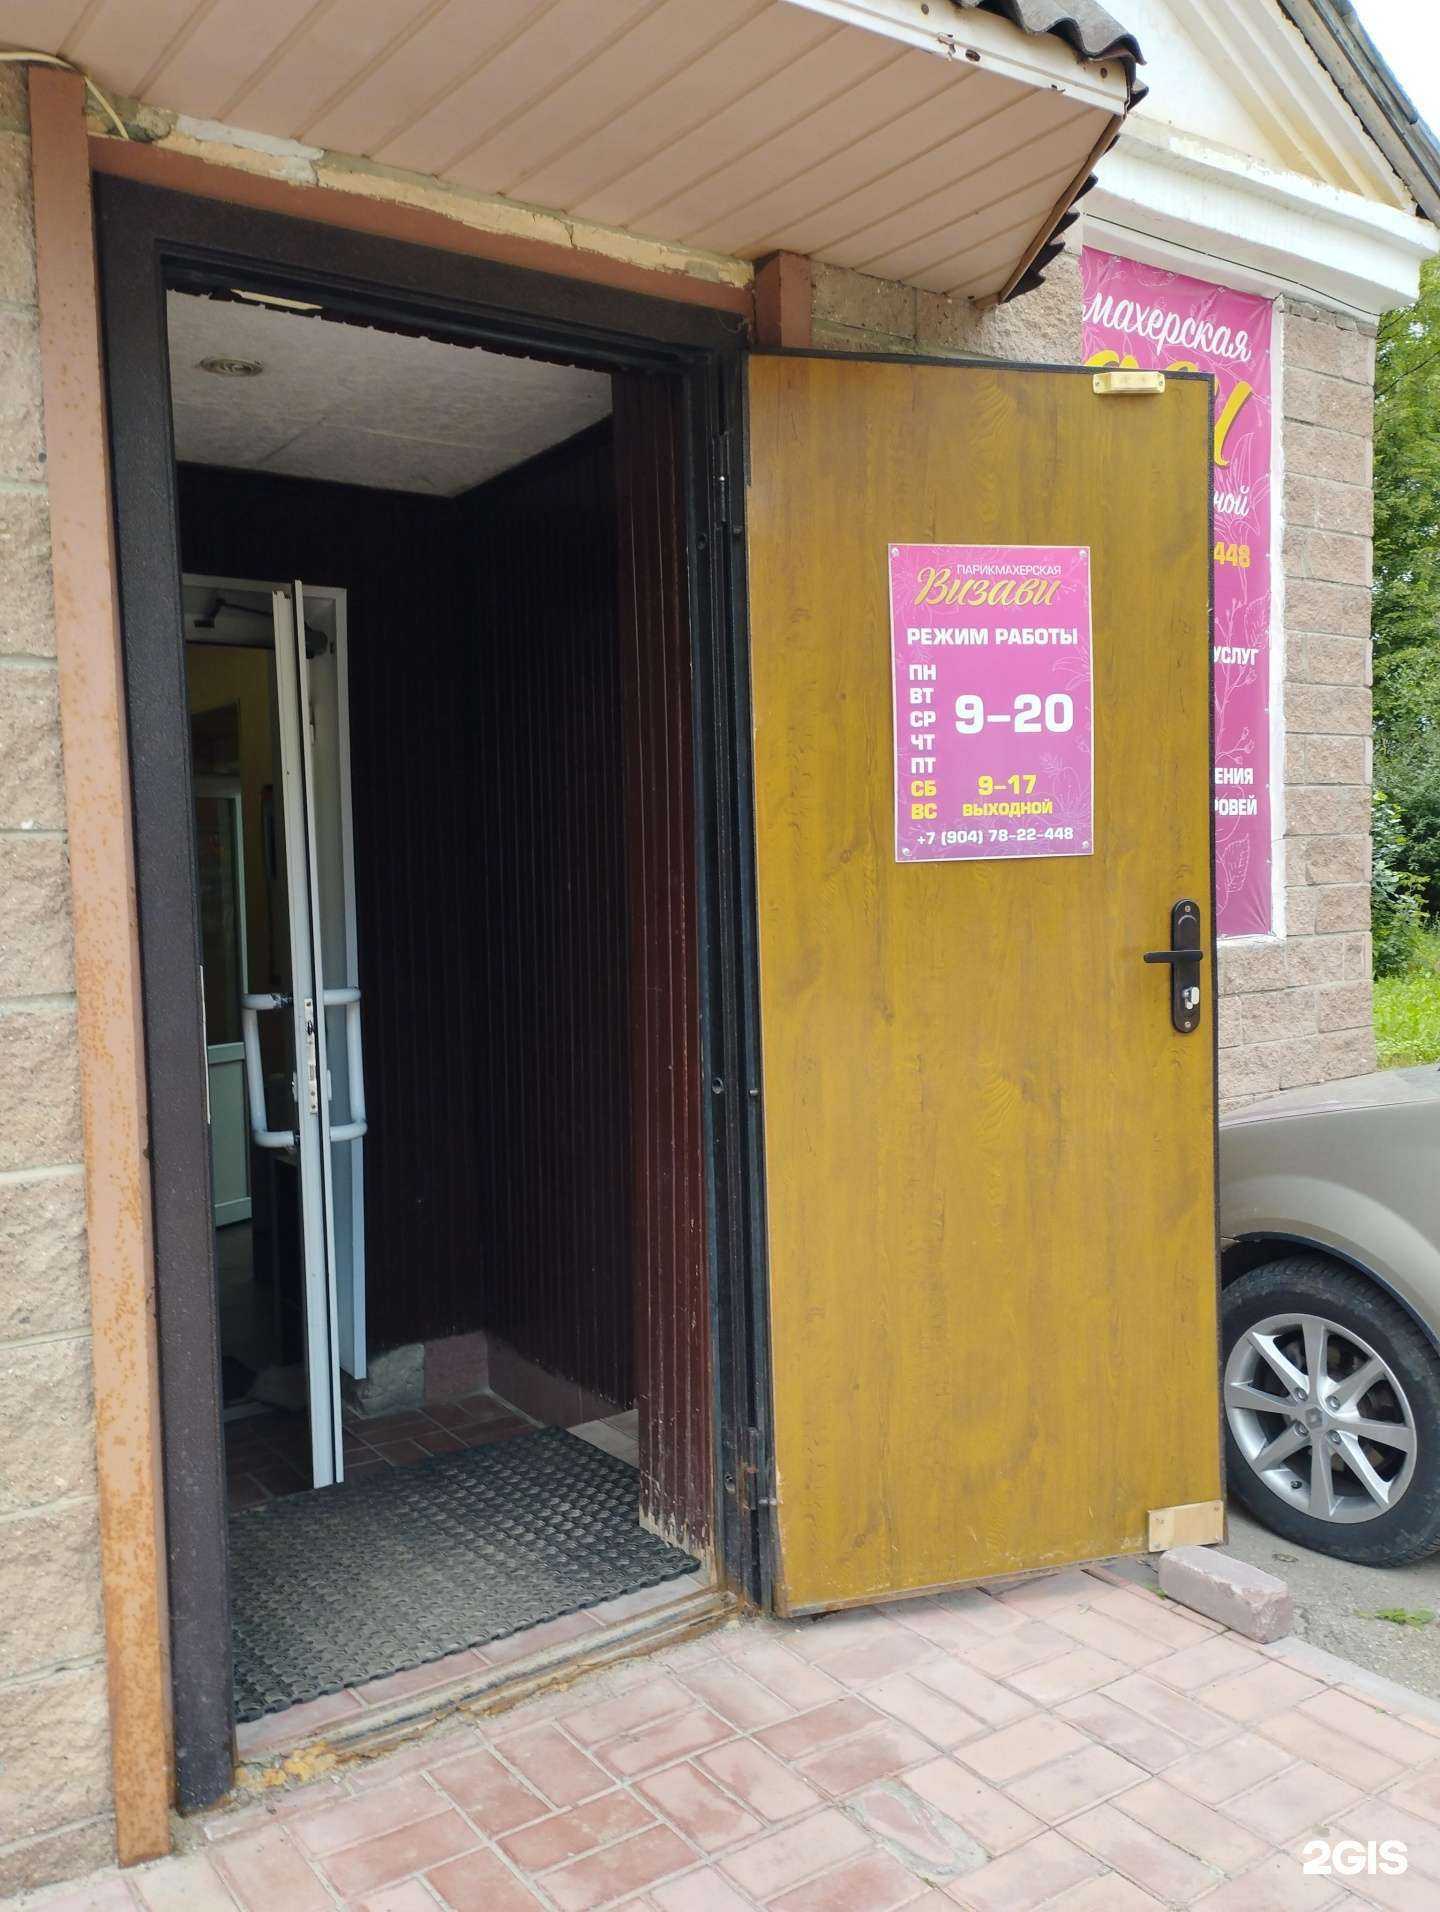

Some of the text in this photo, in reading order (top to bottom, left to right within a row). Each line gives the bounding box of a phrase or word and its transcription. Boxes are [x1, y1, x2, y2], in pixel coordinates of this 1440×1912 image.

[1214, 541, 1250, 568] 448
[956, 564, 1062, 576] ПАРИКМАХЕРСКАЯ
[914, 567, 1062, 607] Визави
[907, 628, 1078, 646] РЕЖИМ РАБОТЫ
[909, 664, 937, 681] ПН
[910, 687, 934, 704] ВТ
[910, 710, 936, 728] СР
[911, 733, 935, 750] ЧТ
[911, 757, 936, 774] ПТ
[1215, 768, 1254, 784] ЕНИЯ
[911, 779, 937, 797] СБ
[911, 799, 1053, 820] ВС ВЫХОДНОЙ
[917, 827, 1074, 846] +7 (904) 78-22-448
